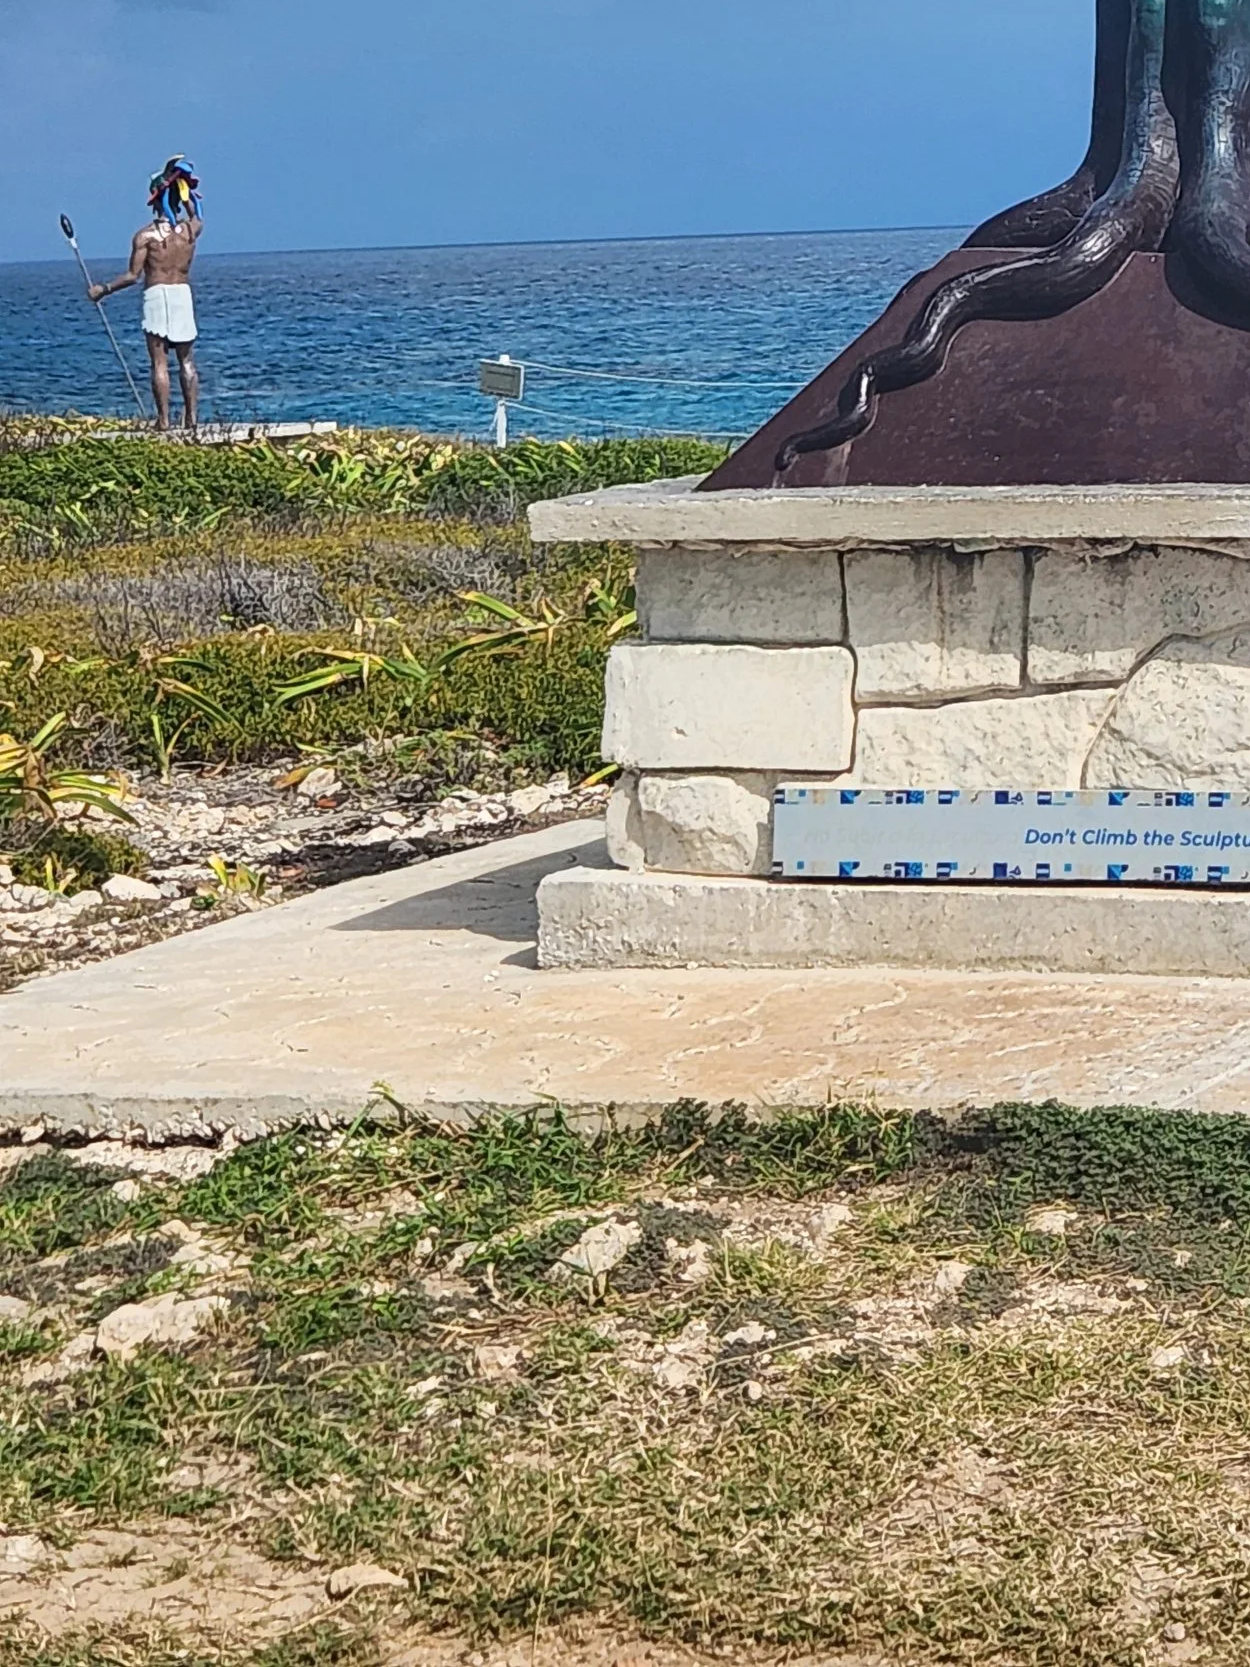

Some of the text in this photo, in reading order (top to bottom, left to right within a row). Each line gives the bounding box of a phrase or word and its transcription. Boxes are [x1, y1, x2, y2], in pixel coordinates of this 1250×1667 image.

[1024, 828, 1077, 845] Don't
[1081, 828, 1138, 845] Climb
[1143, 829, 1175, 846] the
